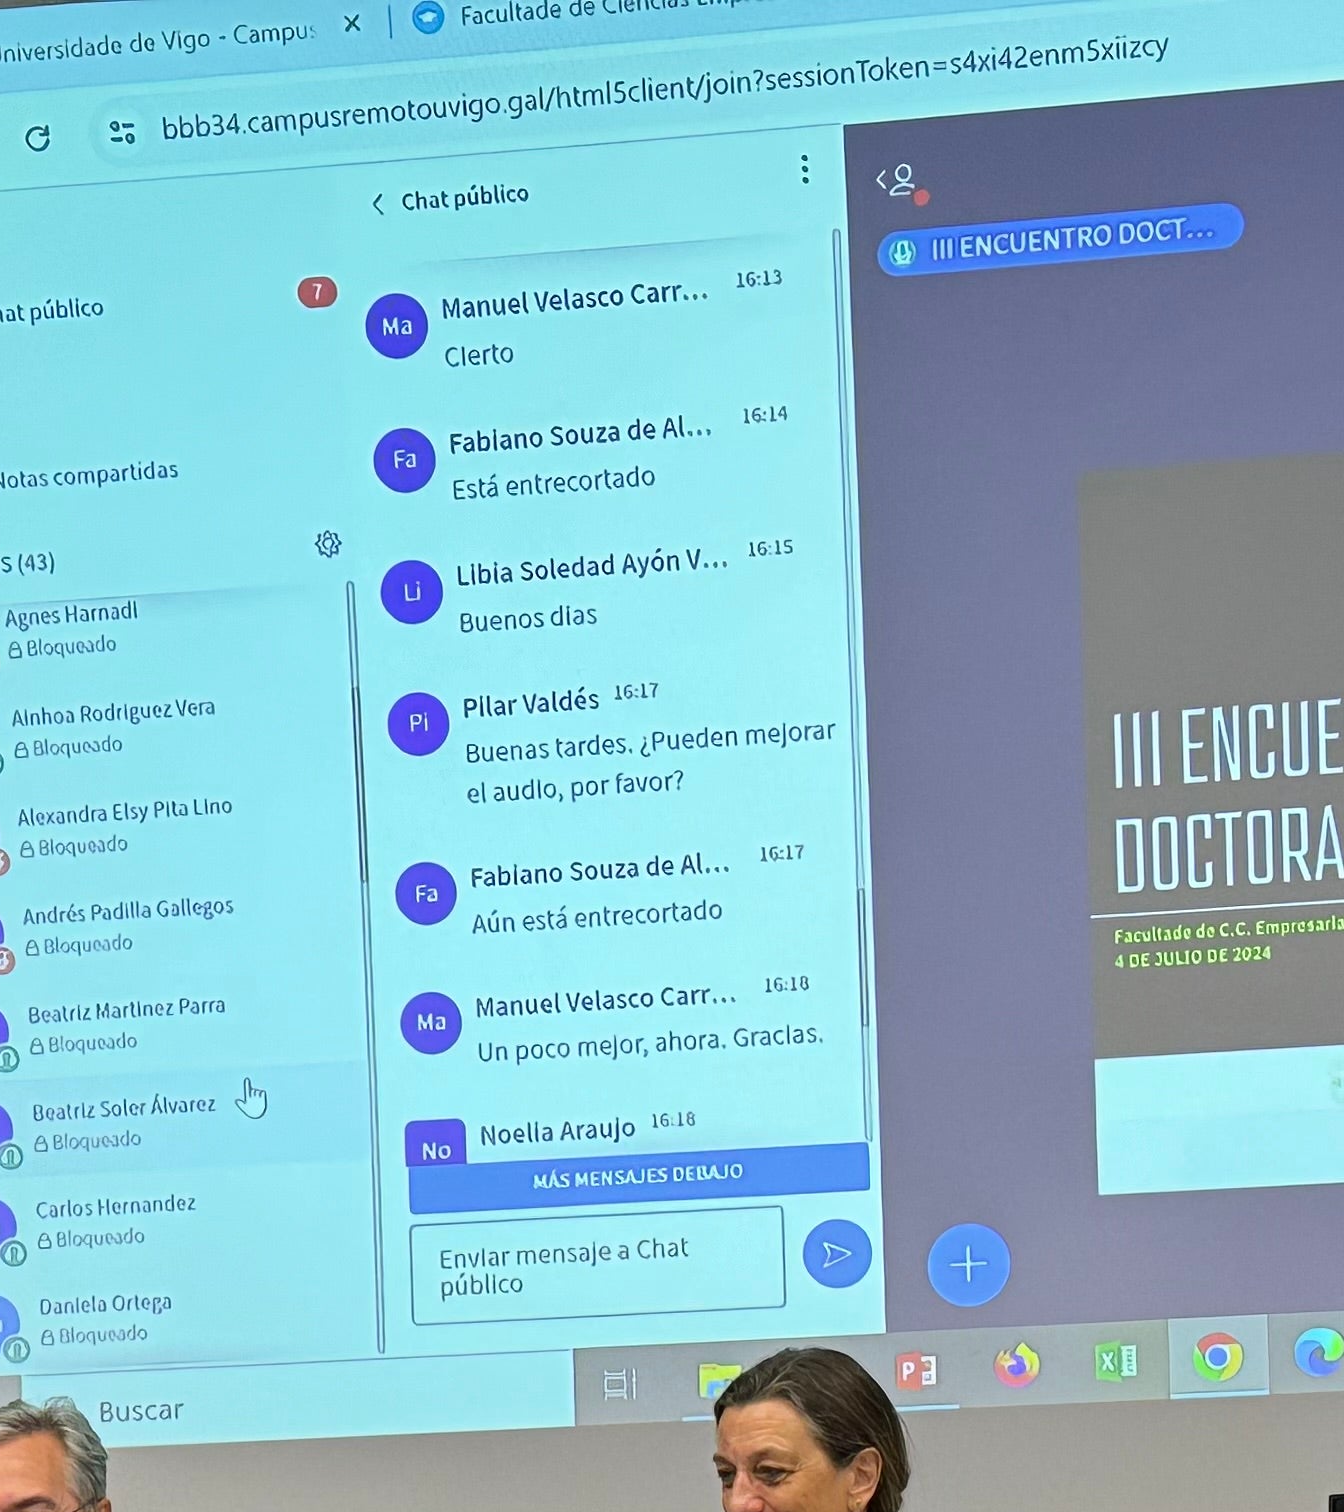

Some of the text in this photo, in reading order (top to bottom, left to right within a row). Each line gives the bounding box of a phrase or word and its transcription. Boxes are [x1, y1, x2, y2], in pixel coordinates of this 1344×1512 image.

[461, 0, 596, 27] Facultade de
[129, 28, 155, 54] de
[162, 29, 210, 54] Vigo
[401, 184, 529, 212] Chat público
[931, 238, 954, 261] III
[960, 224, 1112, 258] ENCUENTRO
[312, 284, 323, 301] 7
[736, 270, 783, 289] 16:13
[30, 298, 105, 325] público
[442, 292, 529, 319] Manuel
[534, 287, 625, 314] Velasco
[382, 317, 413, 337] Ma
[742, 406, 788, 424] 16:14
[450, 427, 544, 454] Fabiano
[550, 423, 621, 448] Souza
[627, 418, 656, 440] de
[394, 450, 417, 469] Fa
[53, 460, 179, 489] compartidas
[452, 466, 656, 500] Está entrecortado
[747, 539, 794, 557] 16:15
[17, 552, 56, 577] (43)
[456, 560, 514, 586] Libia
[520, 552, 615, 581] Soledad
[622, 548, 680, 578] Ayón
[5, 606, 61, 633] Agnes
[459, 608, 545, 633] Buenos
[27, 635, 117, 660] Bloqueado
[463, 687, 599, 719] Pilar Valdés
[614, 682, 660, 701] 16:17
[12, 700, 216, 728] Ainhoa Vera
[409, 713, 429, 732] Pi
[33, 737, 123, 759] Bloqueado
[466, 721, 837, 764] Buenas tardes. ¿Pueden mejorar
[1112, 709, 1161, 789] III
[467, 770, 685, 804] el audio, por favor?
[18, 803, 108, 827] Alexandra
[113, 801, 148, 826] Elsy
[193, 797, 233, 817] Lino
[39, 835, 128, 859] Bloqueado
[760, 844, 805, 863] 16:17
[471, 865, 563, 888] Fabiano
[570, 860, 639, 884] Souza
[646, 854, 675, 877] de
[416, 885, 438, 903] Fa
[23, 898, 234, 926] Andrés Padilla Gallegos
[472, 898, 723, 935] Aún está entrecortado
[1115, 924, 1192, 945] Facultade
[1195, 923, 1216, 940] de
[1219, 920, 1252, 937] C.C.
[44, 935, 133, 958] Bloqueado
[1115, 944, 1271, 969] 4 DE JULIO DE 2024
[764, 975, 809, 994] 16:18
[28, 997, 225, 1024] Beatriz Parra
[476, 990, 561, 1018] Manuel
[567, 987, 655, 1013] Velasco
[417, 1013, 446, 1032] Ma
[49, 1034, 137, 1057] Bloqueado
[477, 1023, 824, 1066] Un poco mejor, ahora. Gracias.
[33, 1093, 216, 1122] Beatriz Soler Álvarez
[651, 1111, 696, 1129] 16:18
[53, 1130, 142, 1153] Bloqueado
[480, 1117, 636, 1149] Noelia Araujo
[422, 1142, 452, 1160] No
[533, 1162, 744, 1190] MÁS MENSAJES DEBAJO
[36, 1193, 196, 1219] Carlos Hernandez
[56, 1227, 145, 1250] Bloqueado
[439, 1235, 689, 1271] Enviar mensaje a Chat
[440, 1273, 524, 1301] público
[40, 1293, 172, 1317] Daniela Ortega
[60, 1324, 148, 1348] Bloqueado
[99, 1399, 184, 1423] Buscar
